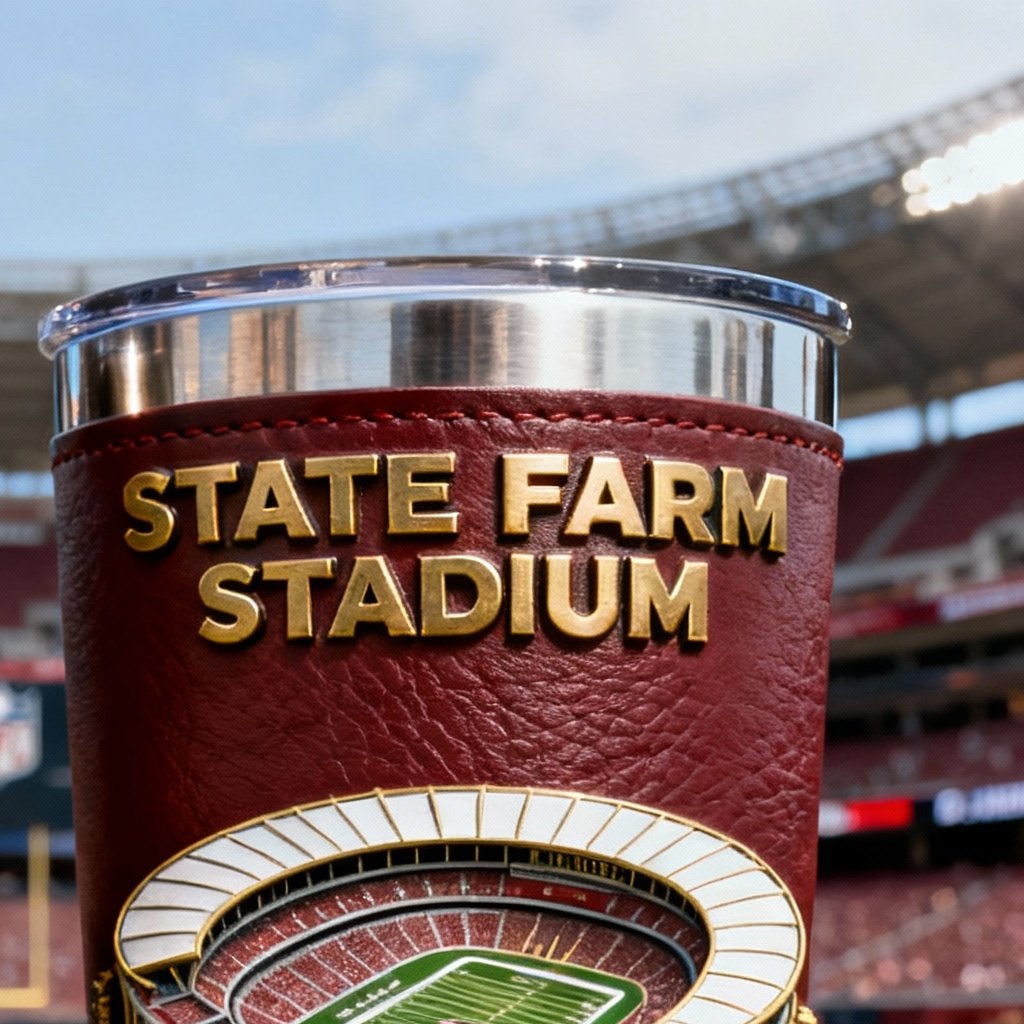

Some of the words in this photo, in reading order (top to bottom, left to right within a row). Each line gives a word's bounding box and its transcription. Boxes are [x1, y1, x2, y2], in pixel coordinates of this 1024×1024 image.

[123, 453, 460, 552] STATE
[500, 452, 789, 554] FARM
[198, 552, 709, 645] STADIUM
